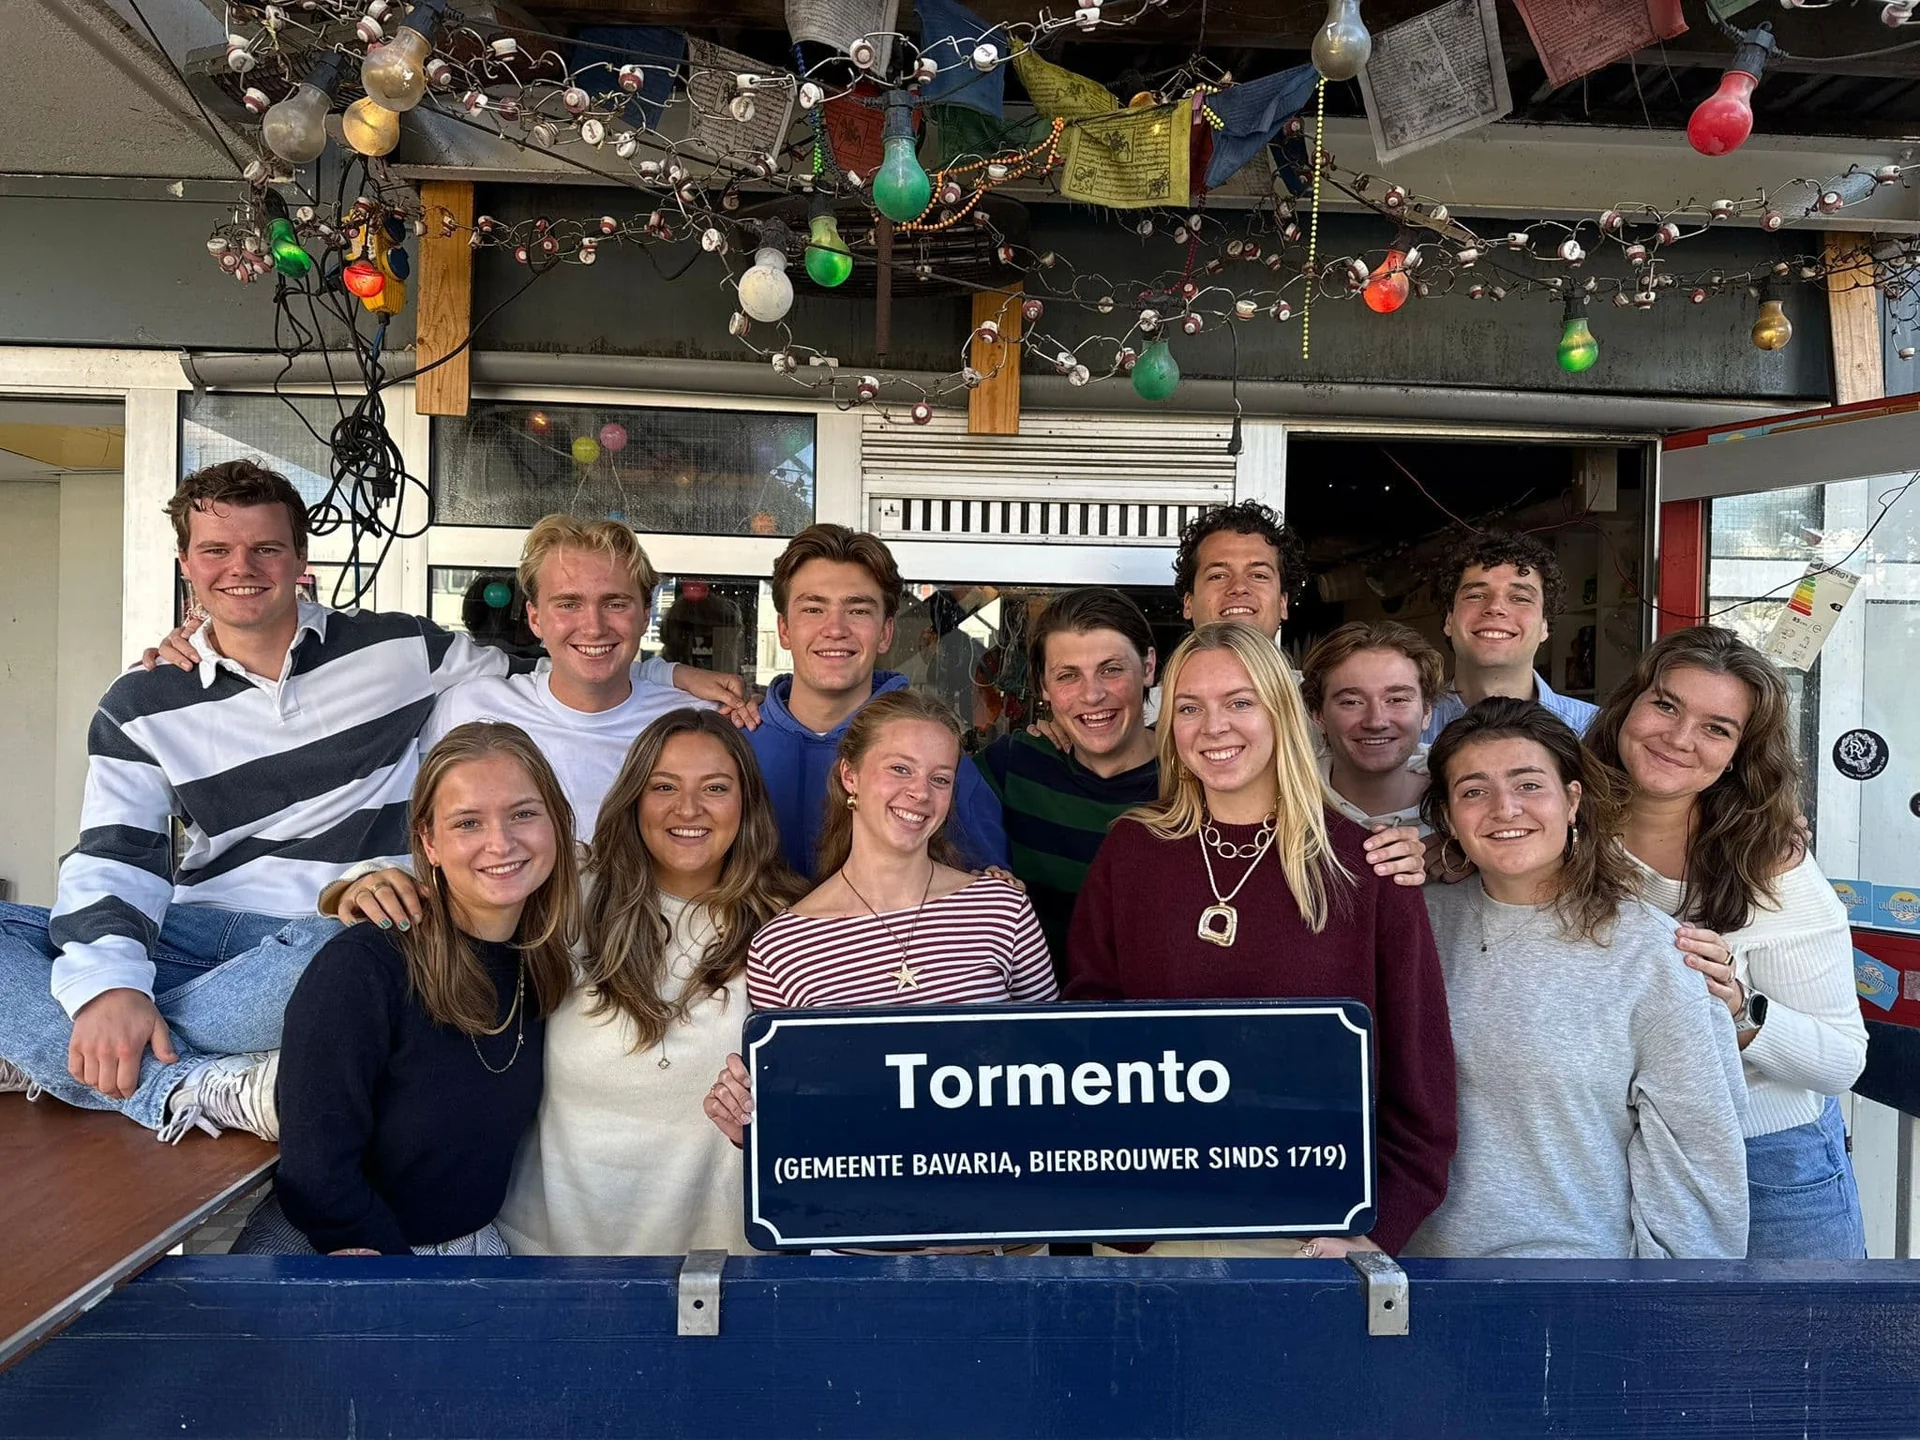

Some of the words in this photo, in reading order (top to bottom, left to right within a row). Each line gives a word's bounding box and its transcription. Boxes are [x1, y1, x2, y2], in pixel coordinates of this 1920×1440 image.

[1903, 903, 1920, 913] SCH
[885, 1051, 1230, 1109] Tormento
[775, 1155, 903, 1184] (GEMEENTE
[913, 1152, 1021, 1178] BAVARIA,
[1030, 1148, 1200, 1172] BIERBROUWER
[1209, 1146, 1279, 1168] SINDS
[1288, 1144, 1347, 1170] 1719)
